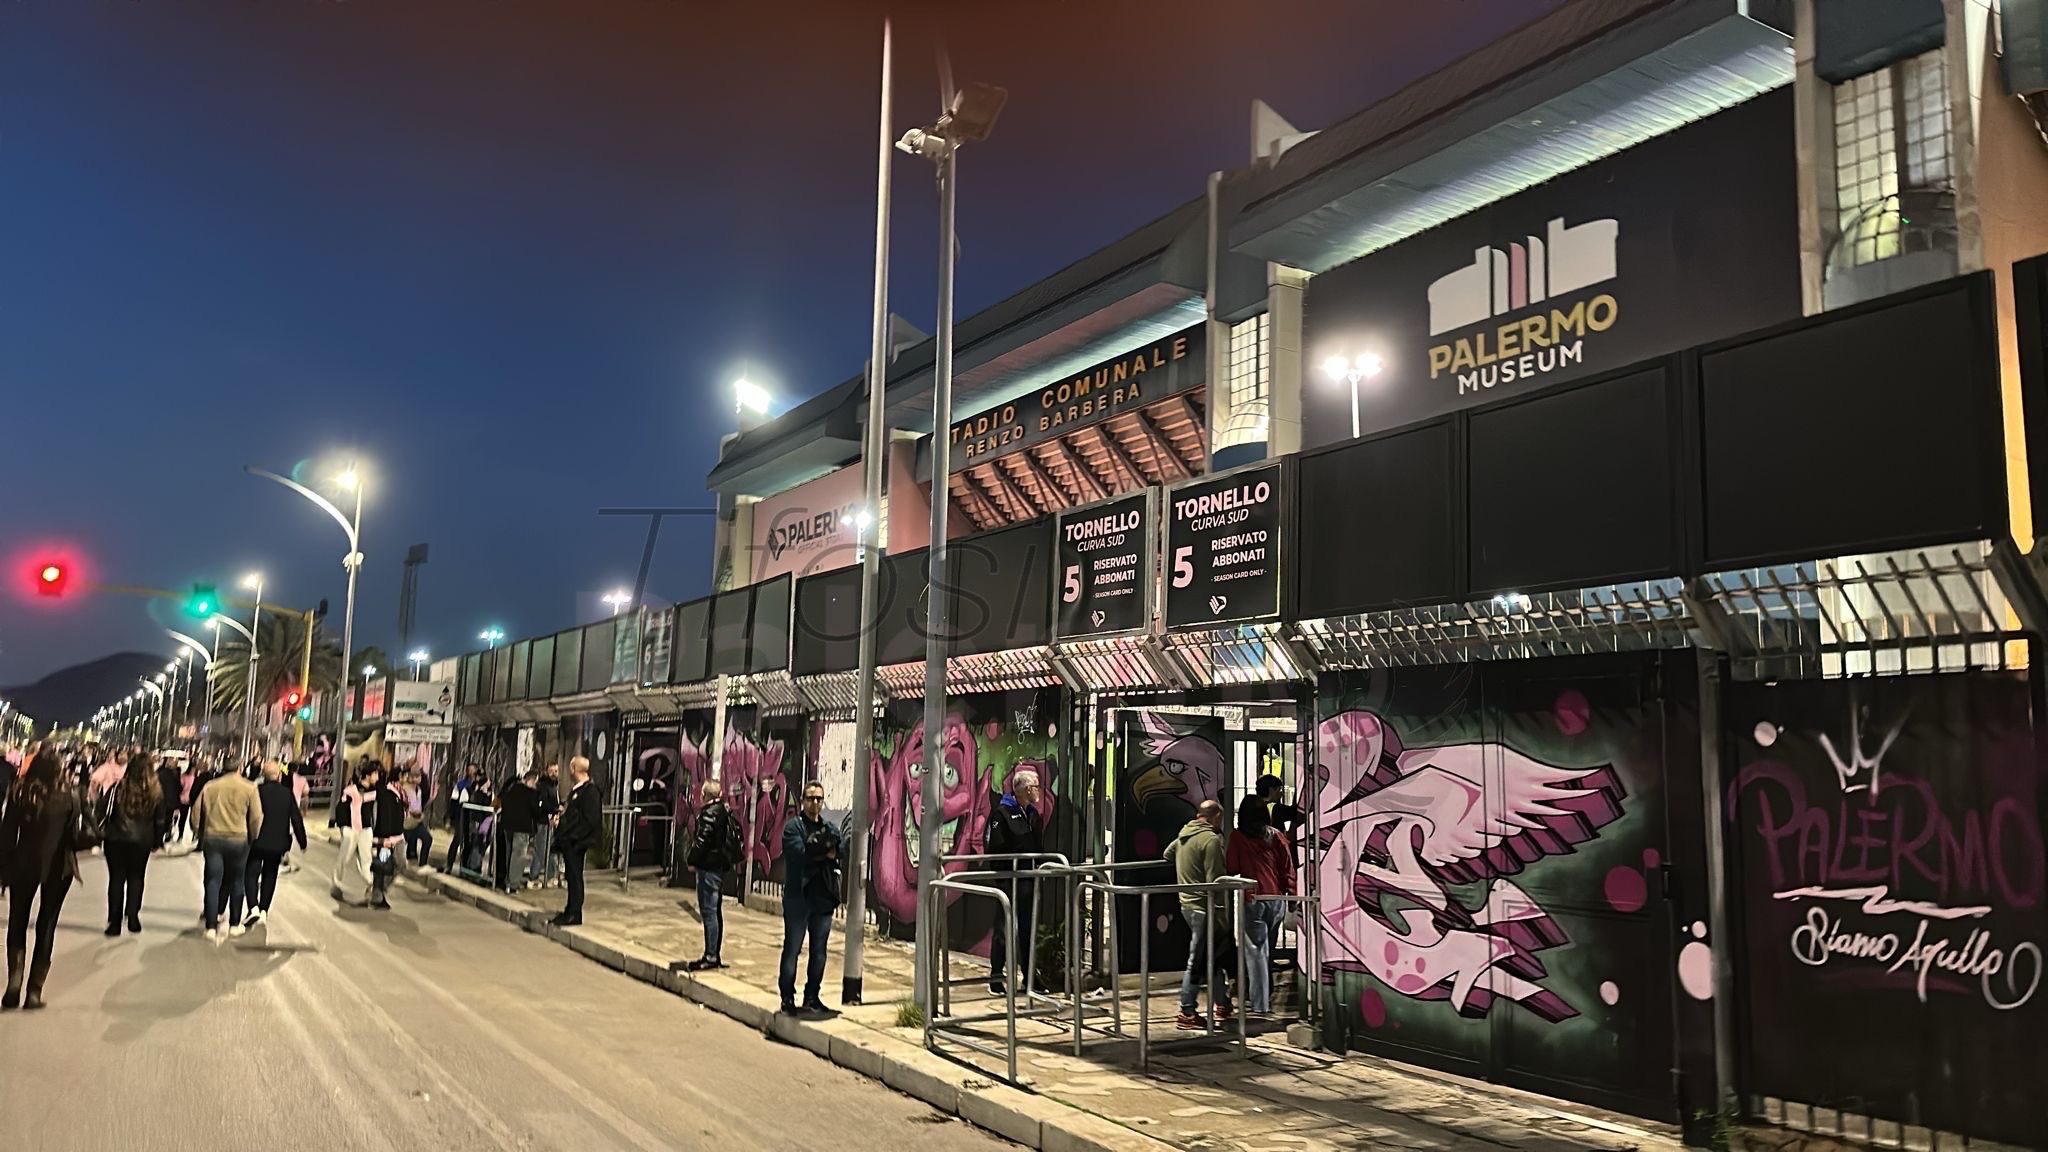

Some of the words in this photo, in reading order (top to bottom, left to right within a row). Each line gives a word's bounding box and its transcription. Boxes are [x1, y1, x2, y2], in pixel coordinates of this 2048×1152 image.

[1429, 294, 1618, 379] PALERMO
[1457, 340, 1583, 395] MUSEUM
[950, 405, 1016, 445] TADIO
[1041, 337, 1188, 409] COMUNALE
[965, 425, 1026, 459] RENZO
[1039, 383, 1140, 431] BARBERA
[1175, 481, 1270, 521] TORNELLO
[1065, 510, 1140, 542] TORNELLO
[1191, 515, 1227, 532] CURVA
[1226, 508, 1249, 524] SUD
[1077, 539, 1106, 552] CURVA
[1106, 533, 1125, 546] SUD
[1211, 530, 1267, 551] RISERVATO
[1212, 547, 1265, 568] ABBONATI
[1093, 553, 1137, 571] RISERVATO
[1094, 569, 1135, 585] ABBONATI
[1172, 546, 1193, 589] 5
[1213, 573, 1234, 582] SEASON
[1233, 571, 1249, 579] CARD
[1249, 569, 1264, 577] ONLY
[1063, 565, 1080, 603] 5
[1727, 762, 2045, 907] PALERMO
